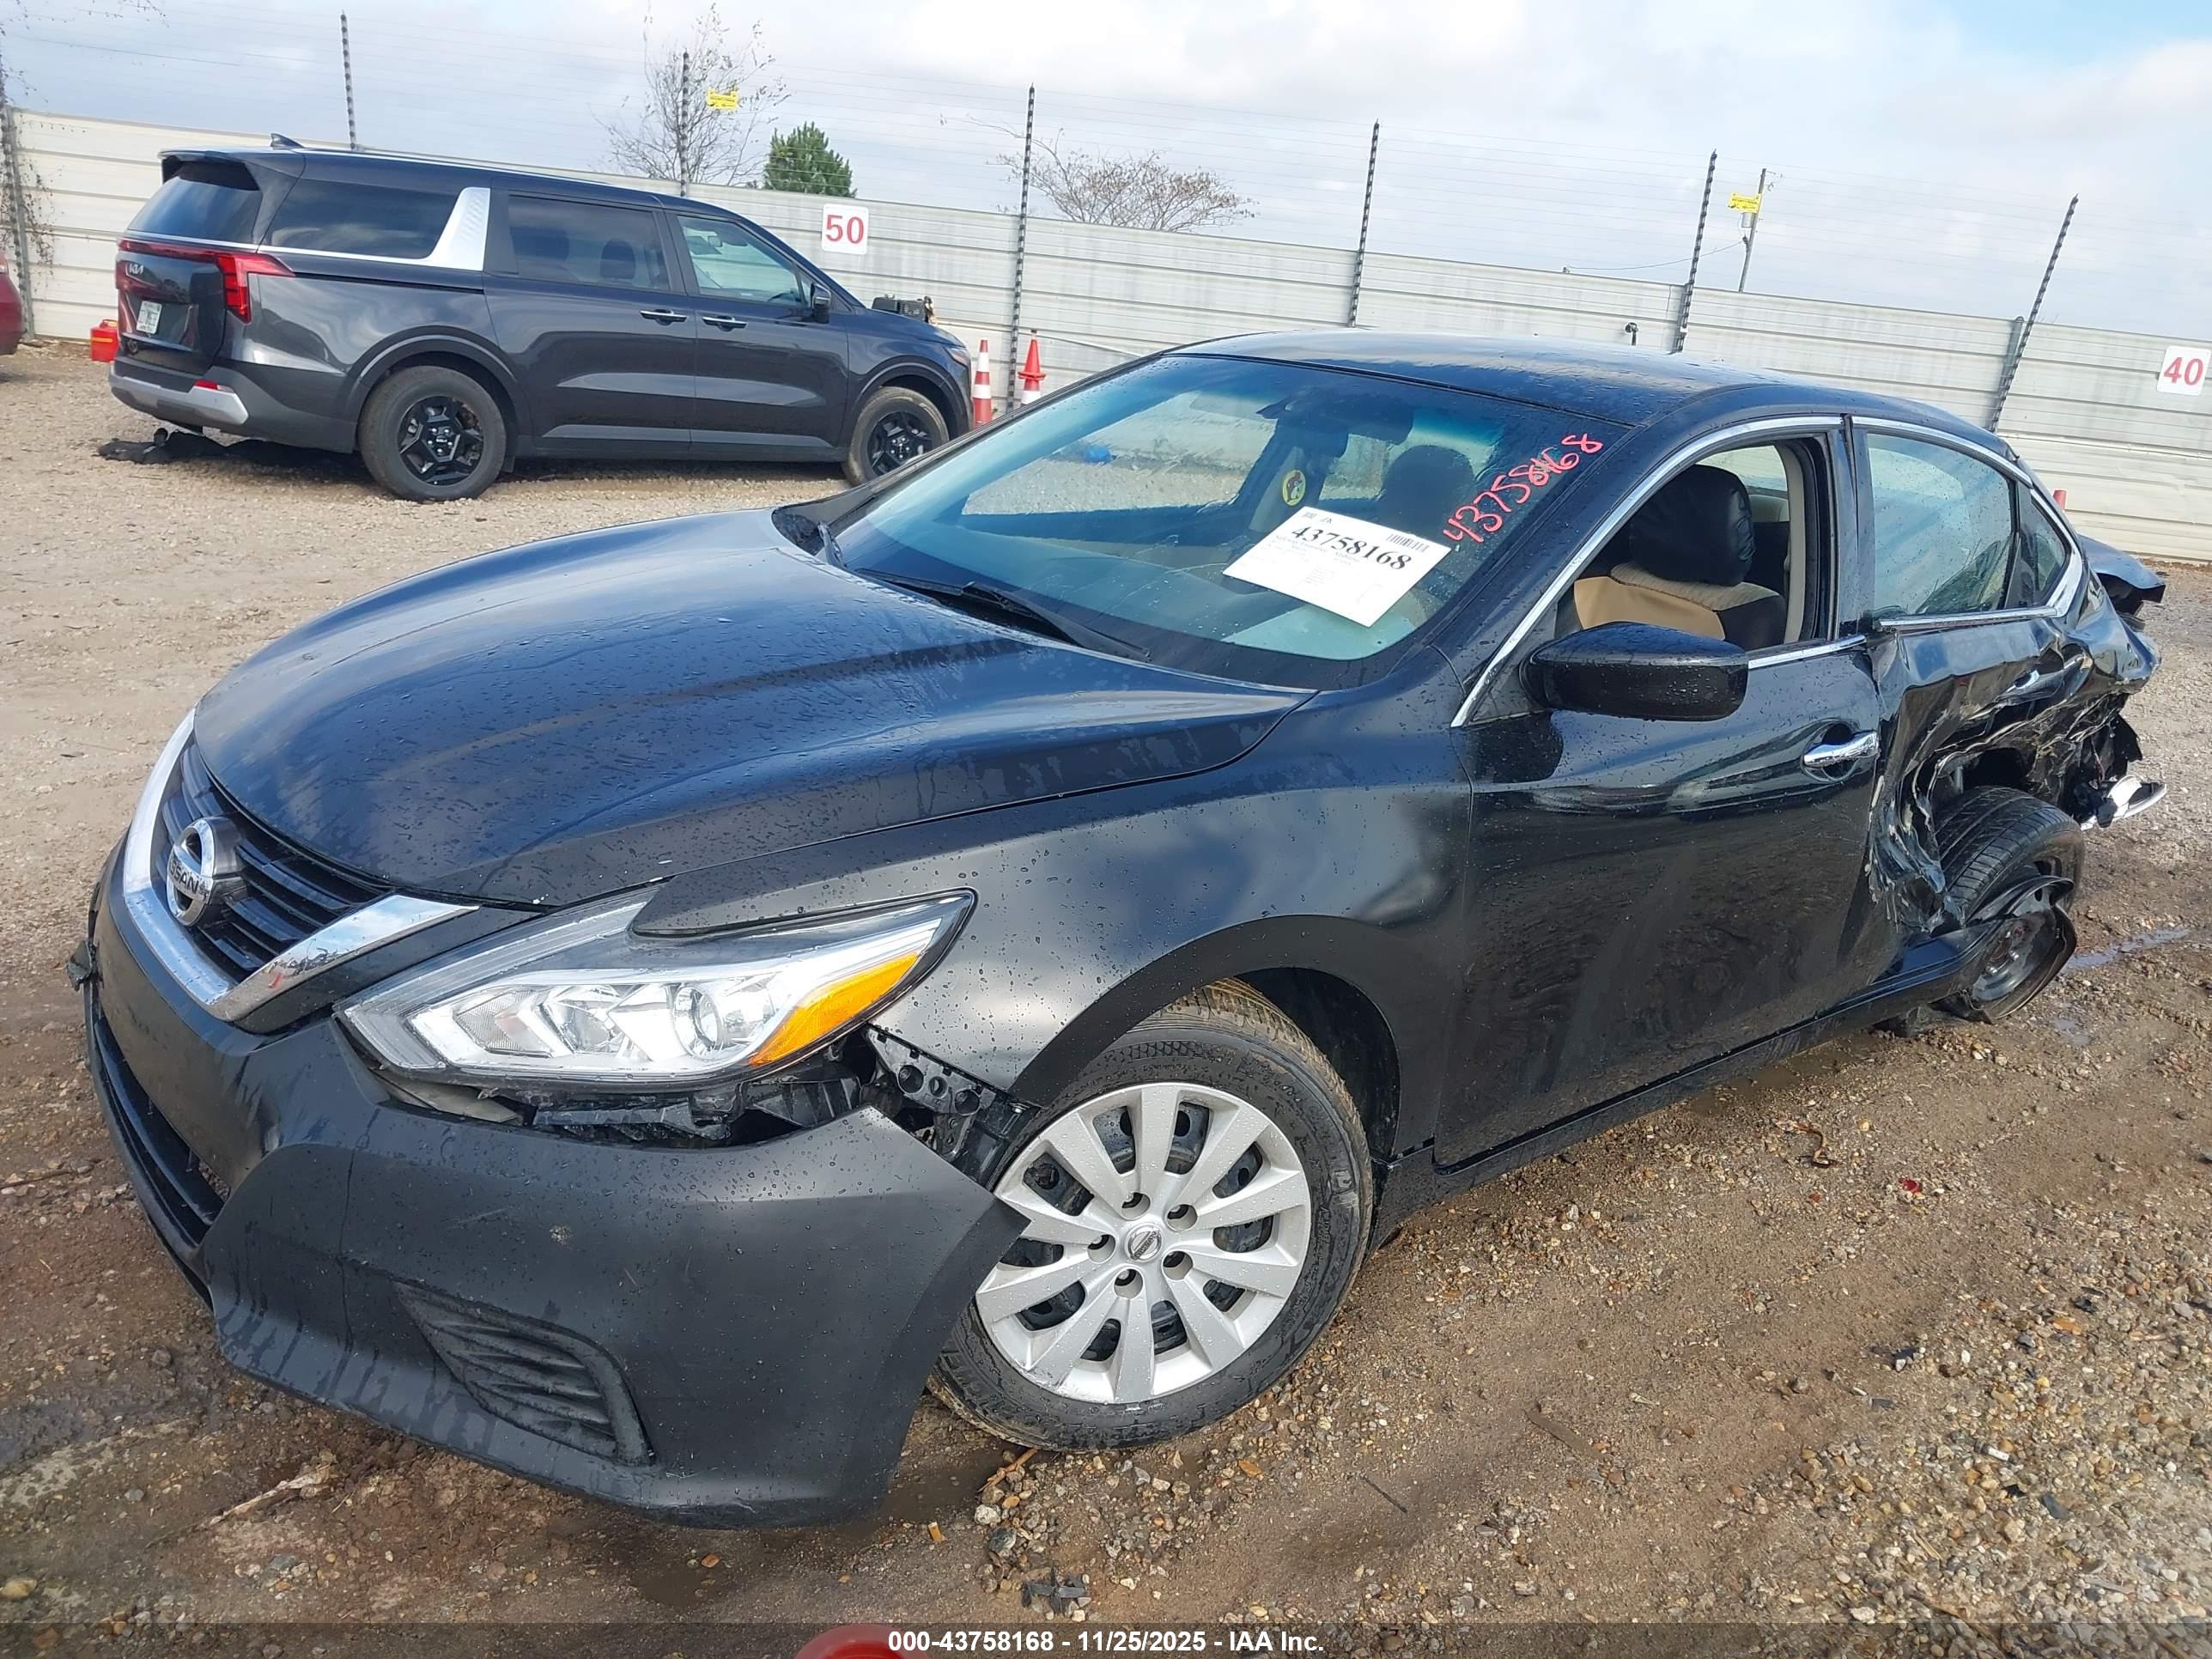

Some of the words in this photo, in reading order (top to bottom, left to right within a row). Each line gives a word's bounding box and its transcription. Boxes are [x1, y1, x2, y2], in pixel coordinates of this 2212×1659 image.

[825, 214, 864, 244] 50
[2164, 356, 2203, 386] 40
[1291, 526, 1413, 570] 43758168
[170, 859, 199, 895] SSAN
